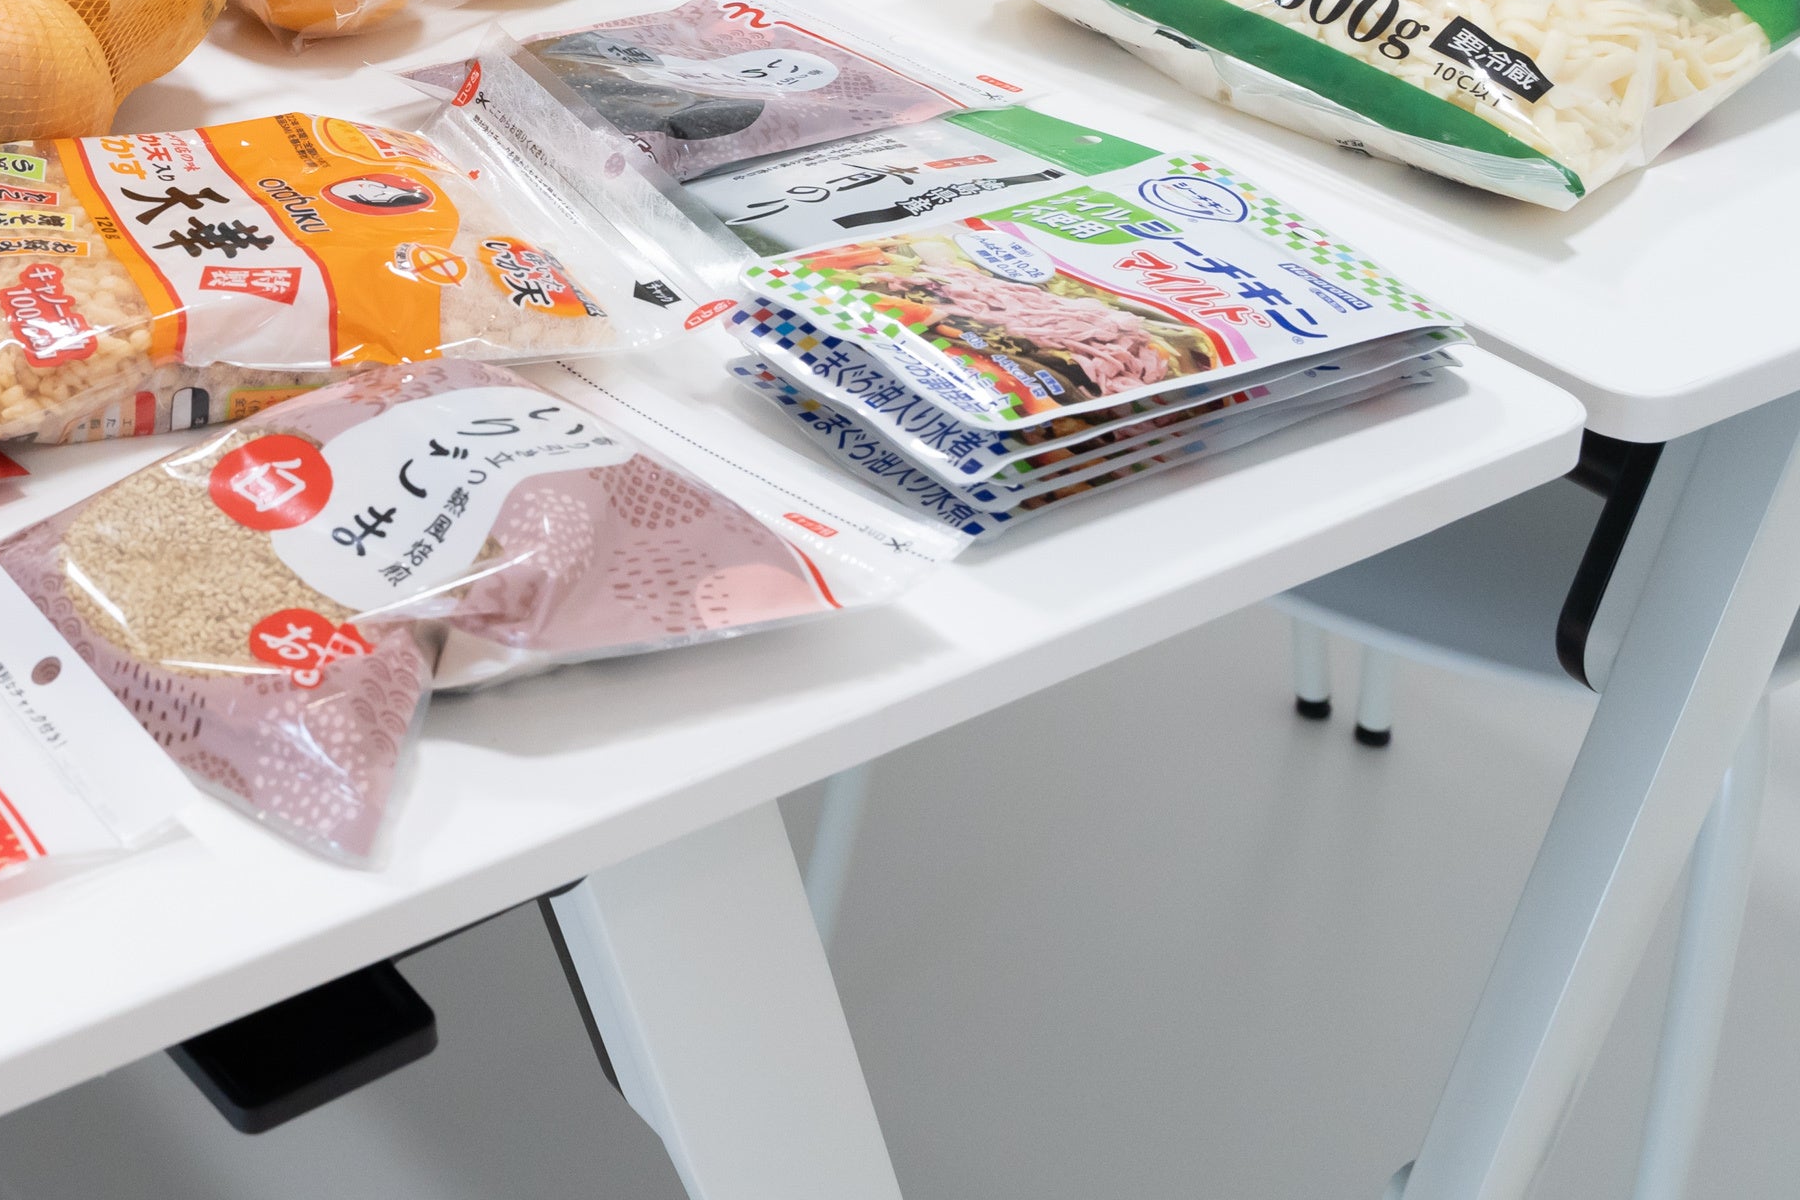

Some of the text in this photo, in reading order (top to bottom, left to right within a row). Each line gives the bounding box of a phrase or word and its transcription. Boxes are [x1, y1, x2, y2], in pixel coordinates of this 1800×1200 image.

[1447, 26, 1541, 92] 要冷蔵
[94, 216, 121, 241] 120g
[120, 185, 275, 259] 天華
[1012, 205, 1114, 240] 不使用
[1048, 195, 1133, 222] オイル
[207, 269, 293, 295] 特製
[484, 241, 553, 307] いか天
[1118, 220, 1328, 338] シーチキン
[1118, 251, 1268, 326] マイルド
[230, 458, 308, 513] 白
[331, 406, 585, 558] いりごま
[378, 434, 620, 589] 香り引き立つ熱風焙煎
